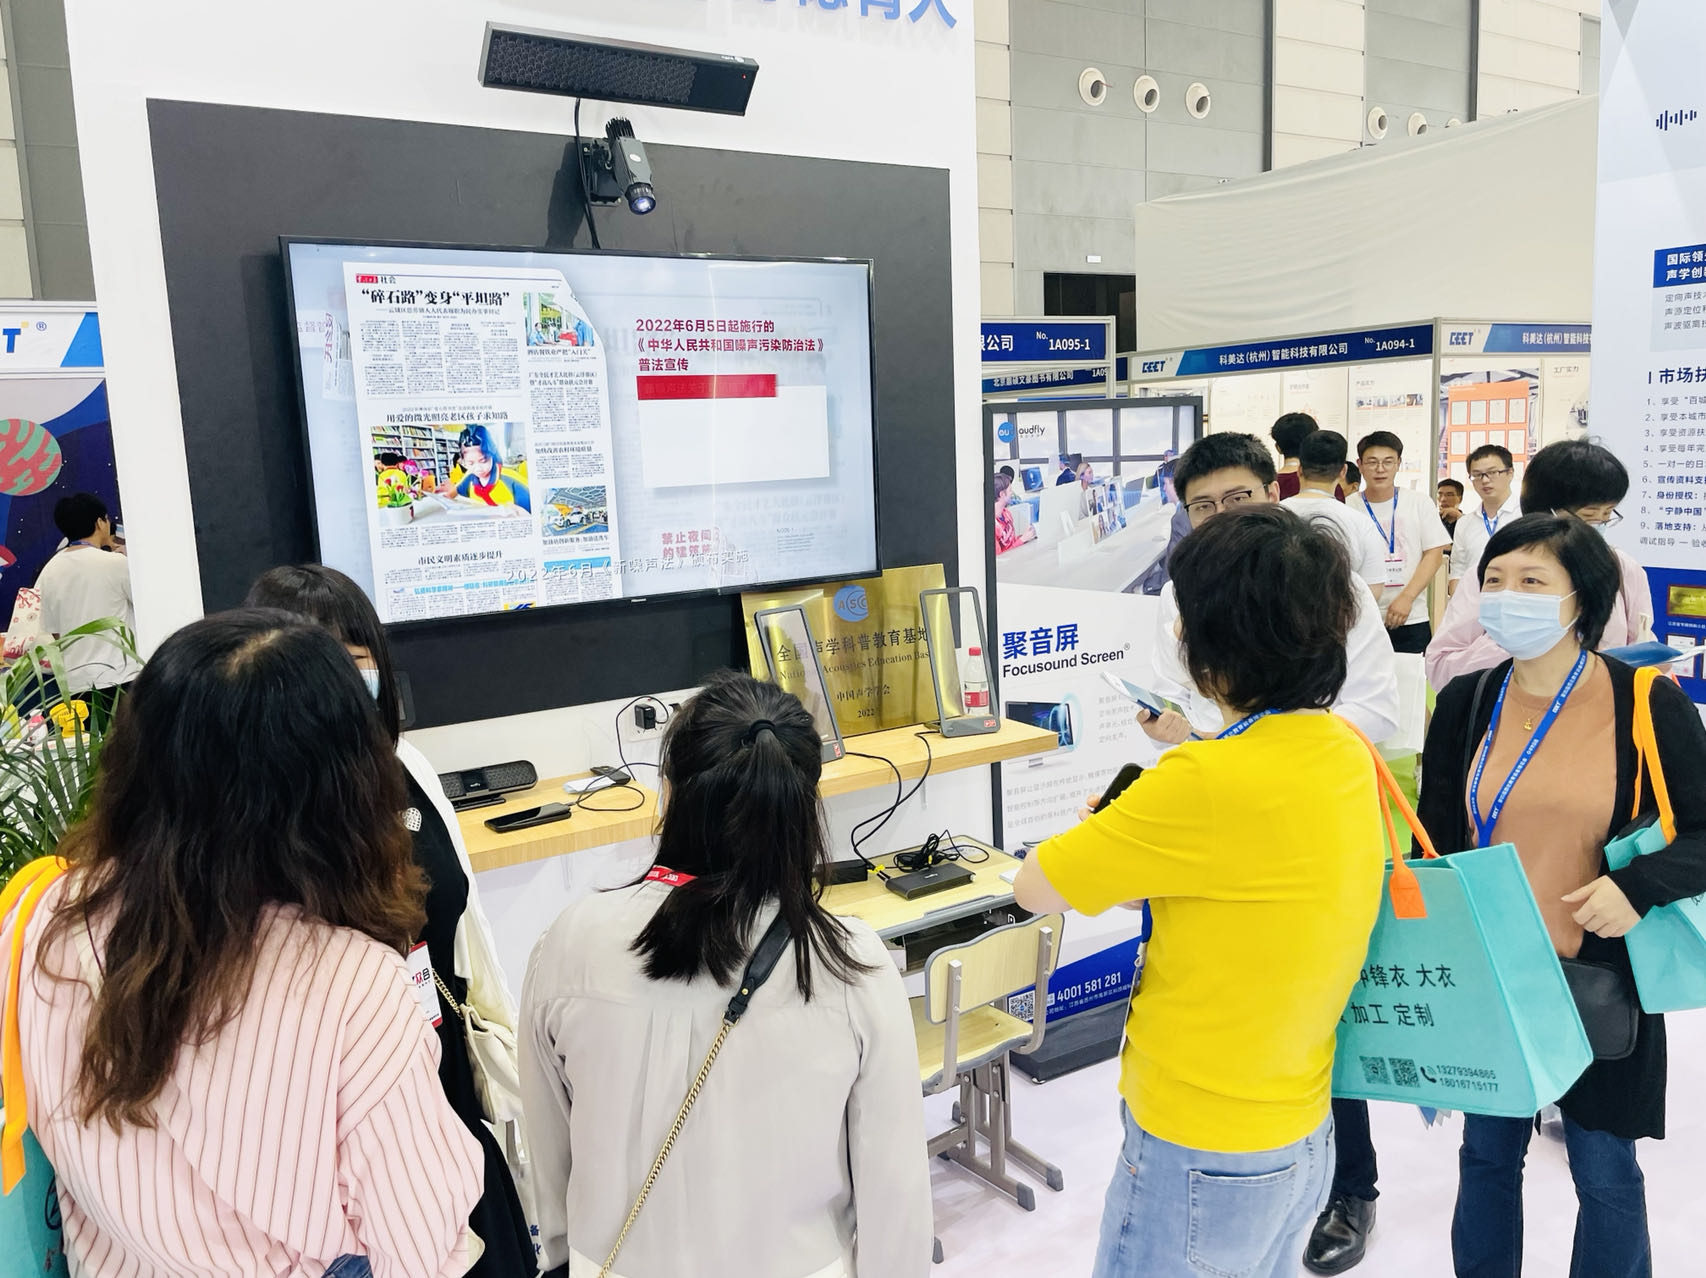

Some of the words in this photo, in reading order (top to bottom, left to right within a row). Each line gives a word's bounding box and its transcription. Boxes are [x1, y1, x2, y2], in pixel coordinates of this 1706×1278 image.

[1666, 250, 1706, 266] 国际领
[1665, 266, 1706, 281] 声学创
[636, 318, 775, 333] 2022年6月5日起施行的
[636, 338, 824, 352] 《中华人民共和国噪声污染防治法》
[1036, 331, 1048, 340] No.
[1048, 338, 1090, 351] 1A095-1
[1364, 336, 1376, 344] No.
[1375, 338, 1416, 352] 1A094-1
[1522, 332, 1591, 345] 科美达(杭州)智能科技
[638, 357, 690, 372] 普法宣传
[1018, 424, 1046, 437] audfly
[1643, 459, 1706, 469] 5、一对一的日
[1642, 475, 1706, 485] 6、宣传资料支
[1641, 490, 1706, 500] 7、身份授权：
[1002, 623, 1080, 660] 聚音屏
[914, 649, 930, 660] Bas
[1002, 654, 1078, 678] Focusound
[857, 708, 876, 719] 2022
[1416, 963, 1456, 988] 大衣
[1057, 984, 1082, 1002] 4001
[1084, 977, 1102, 994] 581
[1104, 971, 1121, 988] 281
[1351, 1002, 1389, 1024] 加工
[1393, 1003, 1435, 1027] 定制
